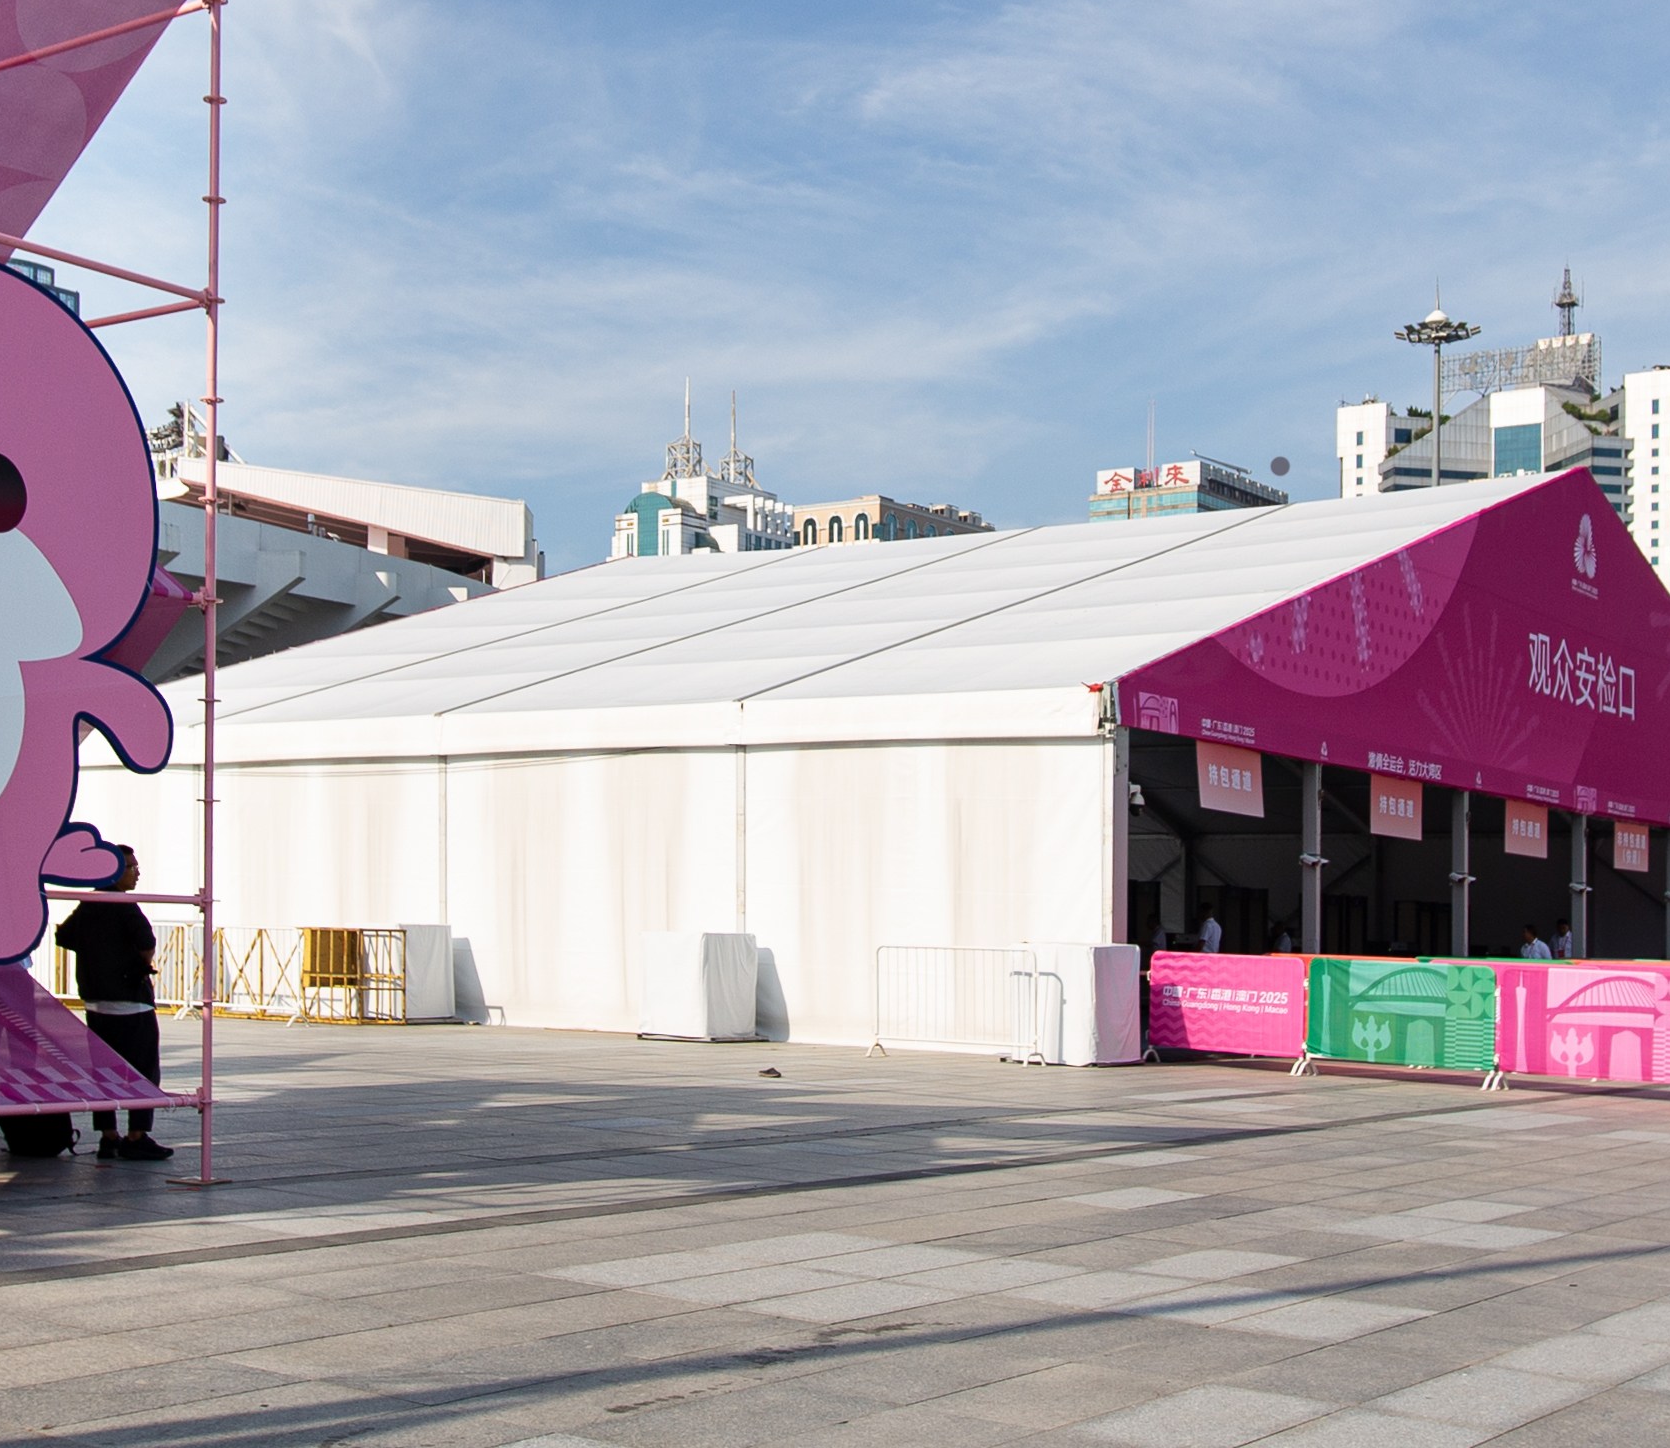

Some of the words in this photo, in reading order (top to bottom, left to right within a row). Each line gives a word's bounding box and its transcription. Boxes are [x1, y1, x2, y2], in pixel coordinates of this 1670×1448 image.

[1103, 464, 1190, 493] 金利來
[1529, 632, 1635, 721] 观众安检口
[1208, 763, 1252, 792] 持包通道
[1379, 794, 1414, 818] 持包通道
[1162, 998, 1181, 1007] China
[1181, 1000, 1219, 1011] Guangdong
[1223, 1002, 1241, 1013] Hong
[1242, 1003, 1260, 1014] Kong
[1264, 1005, 1288, 1015] Macao
[1258, 991, 1288, 1005] 2025
